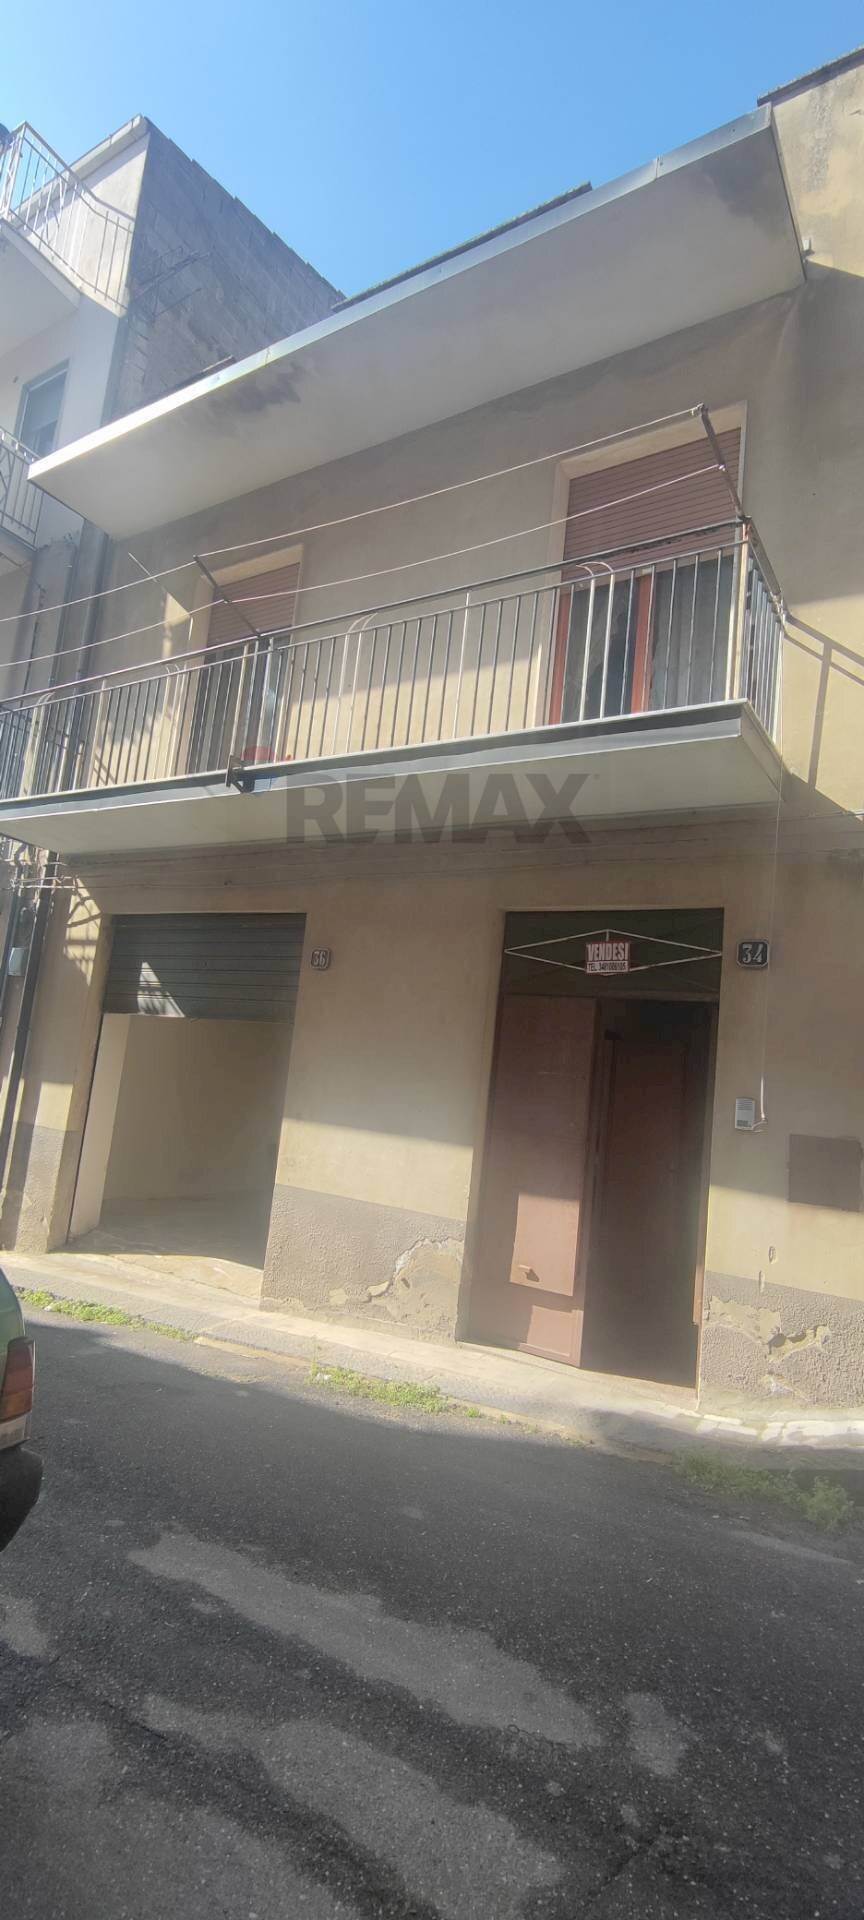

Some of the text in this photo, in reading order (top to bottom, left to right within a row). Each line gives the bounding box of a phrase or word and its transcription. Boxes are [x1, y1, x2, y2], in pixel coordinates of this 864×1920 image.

[313, 951, 326, 966] 36
[586, 942, 629, 961] VENDESI
[742, 943, 764, 963] 34
